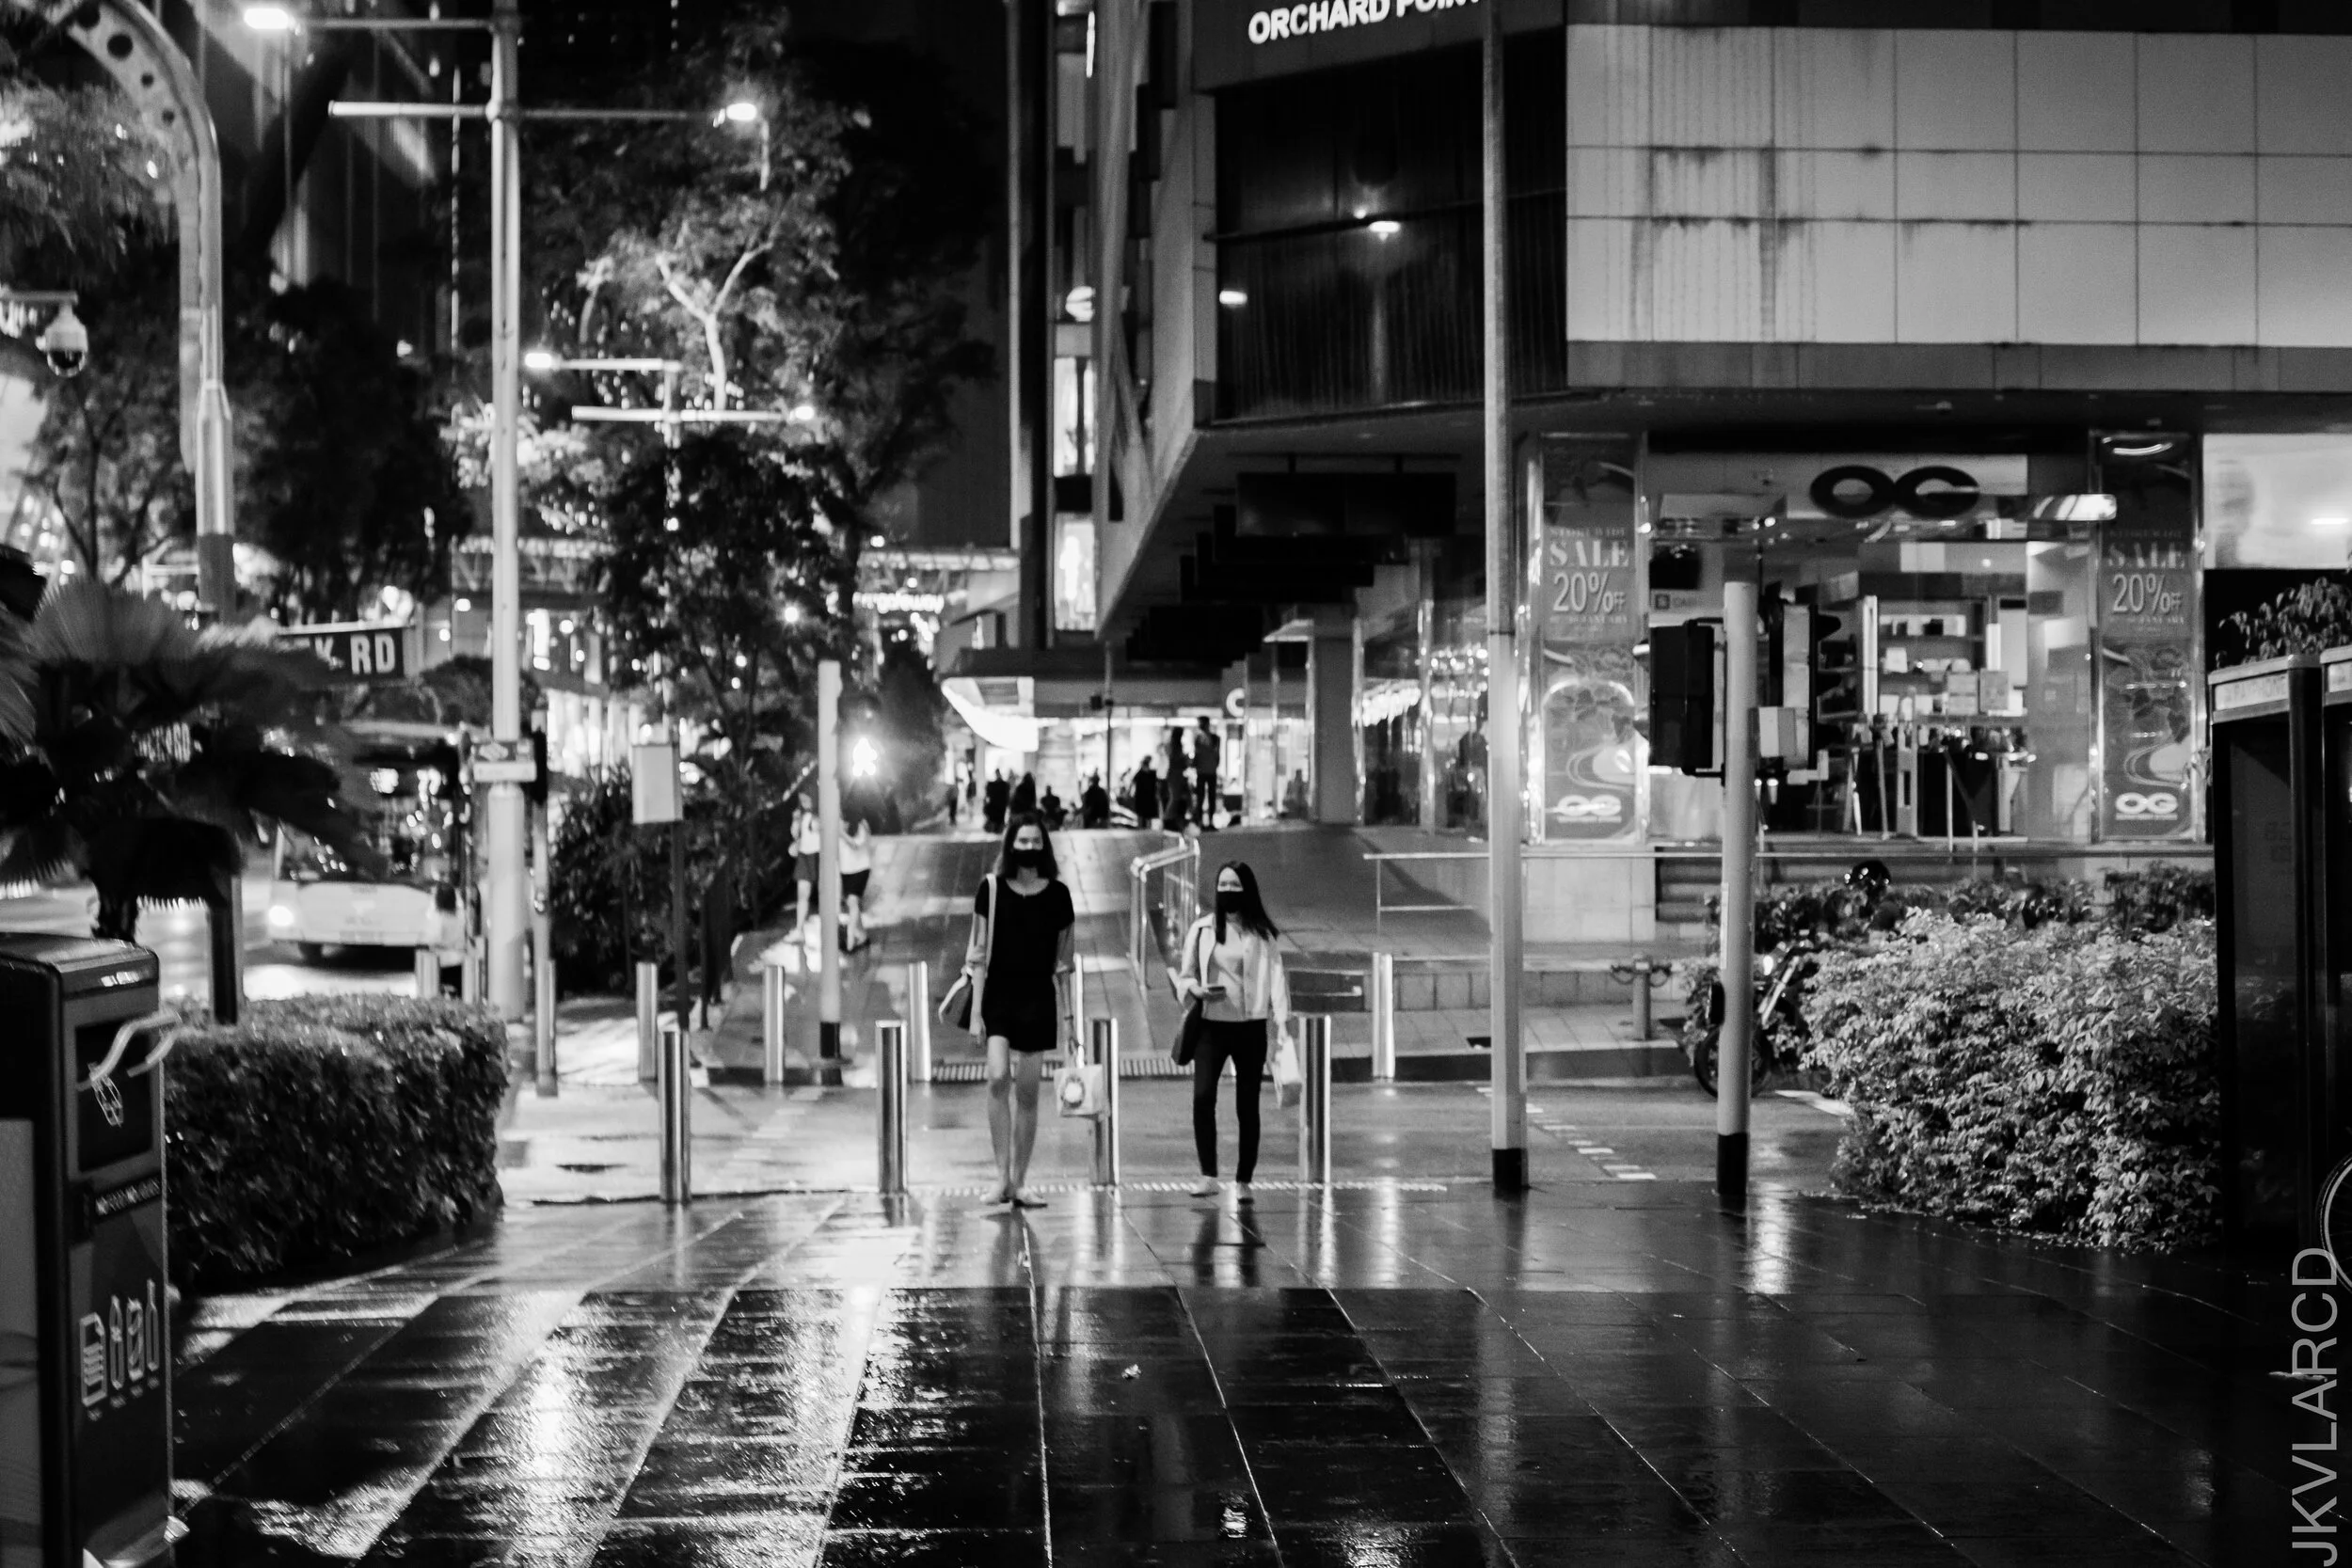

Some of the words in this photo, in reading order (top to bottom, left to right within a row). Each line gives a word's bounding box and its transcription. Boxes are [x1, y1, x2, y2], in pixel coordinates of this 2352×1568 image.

[1248, 0, 1391, 44] ORCHARD
[1809, 465, 1980, 518] OG
[1549, 539, 1629, 567] SALE
[2108, 542, 2185, 569] SALE
[350, 633, 396, 674] RD
[2115, 791, 2179, 816] OG
